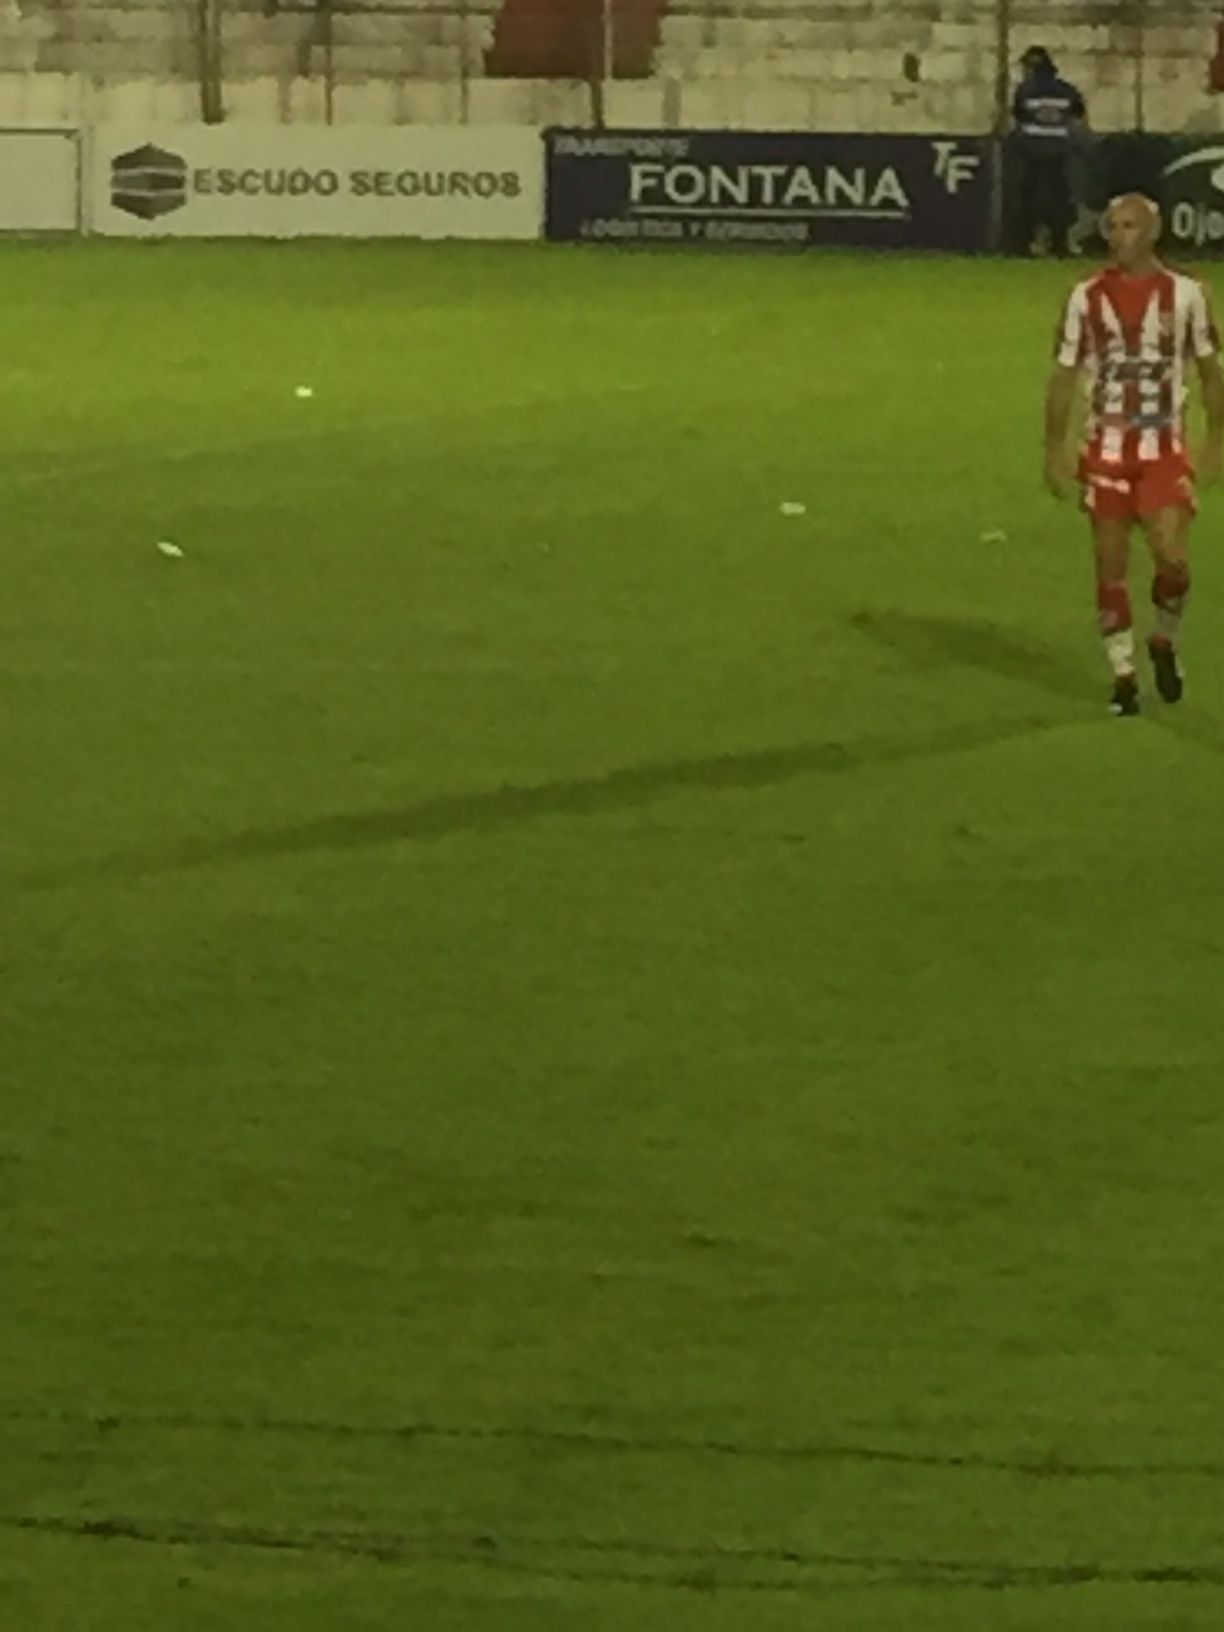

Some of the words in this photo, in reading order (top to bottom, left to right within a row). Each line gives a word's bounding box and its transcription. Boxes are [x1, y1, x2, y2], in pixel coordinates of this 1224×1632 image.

[194, 169, 339, 196] ESCUDO
[350, 171, 522, 198] SEGUROS
[630, 164, 909, 207] FONTANA
